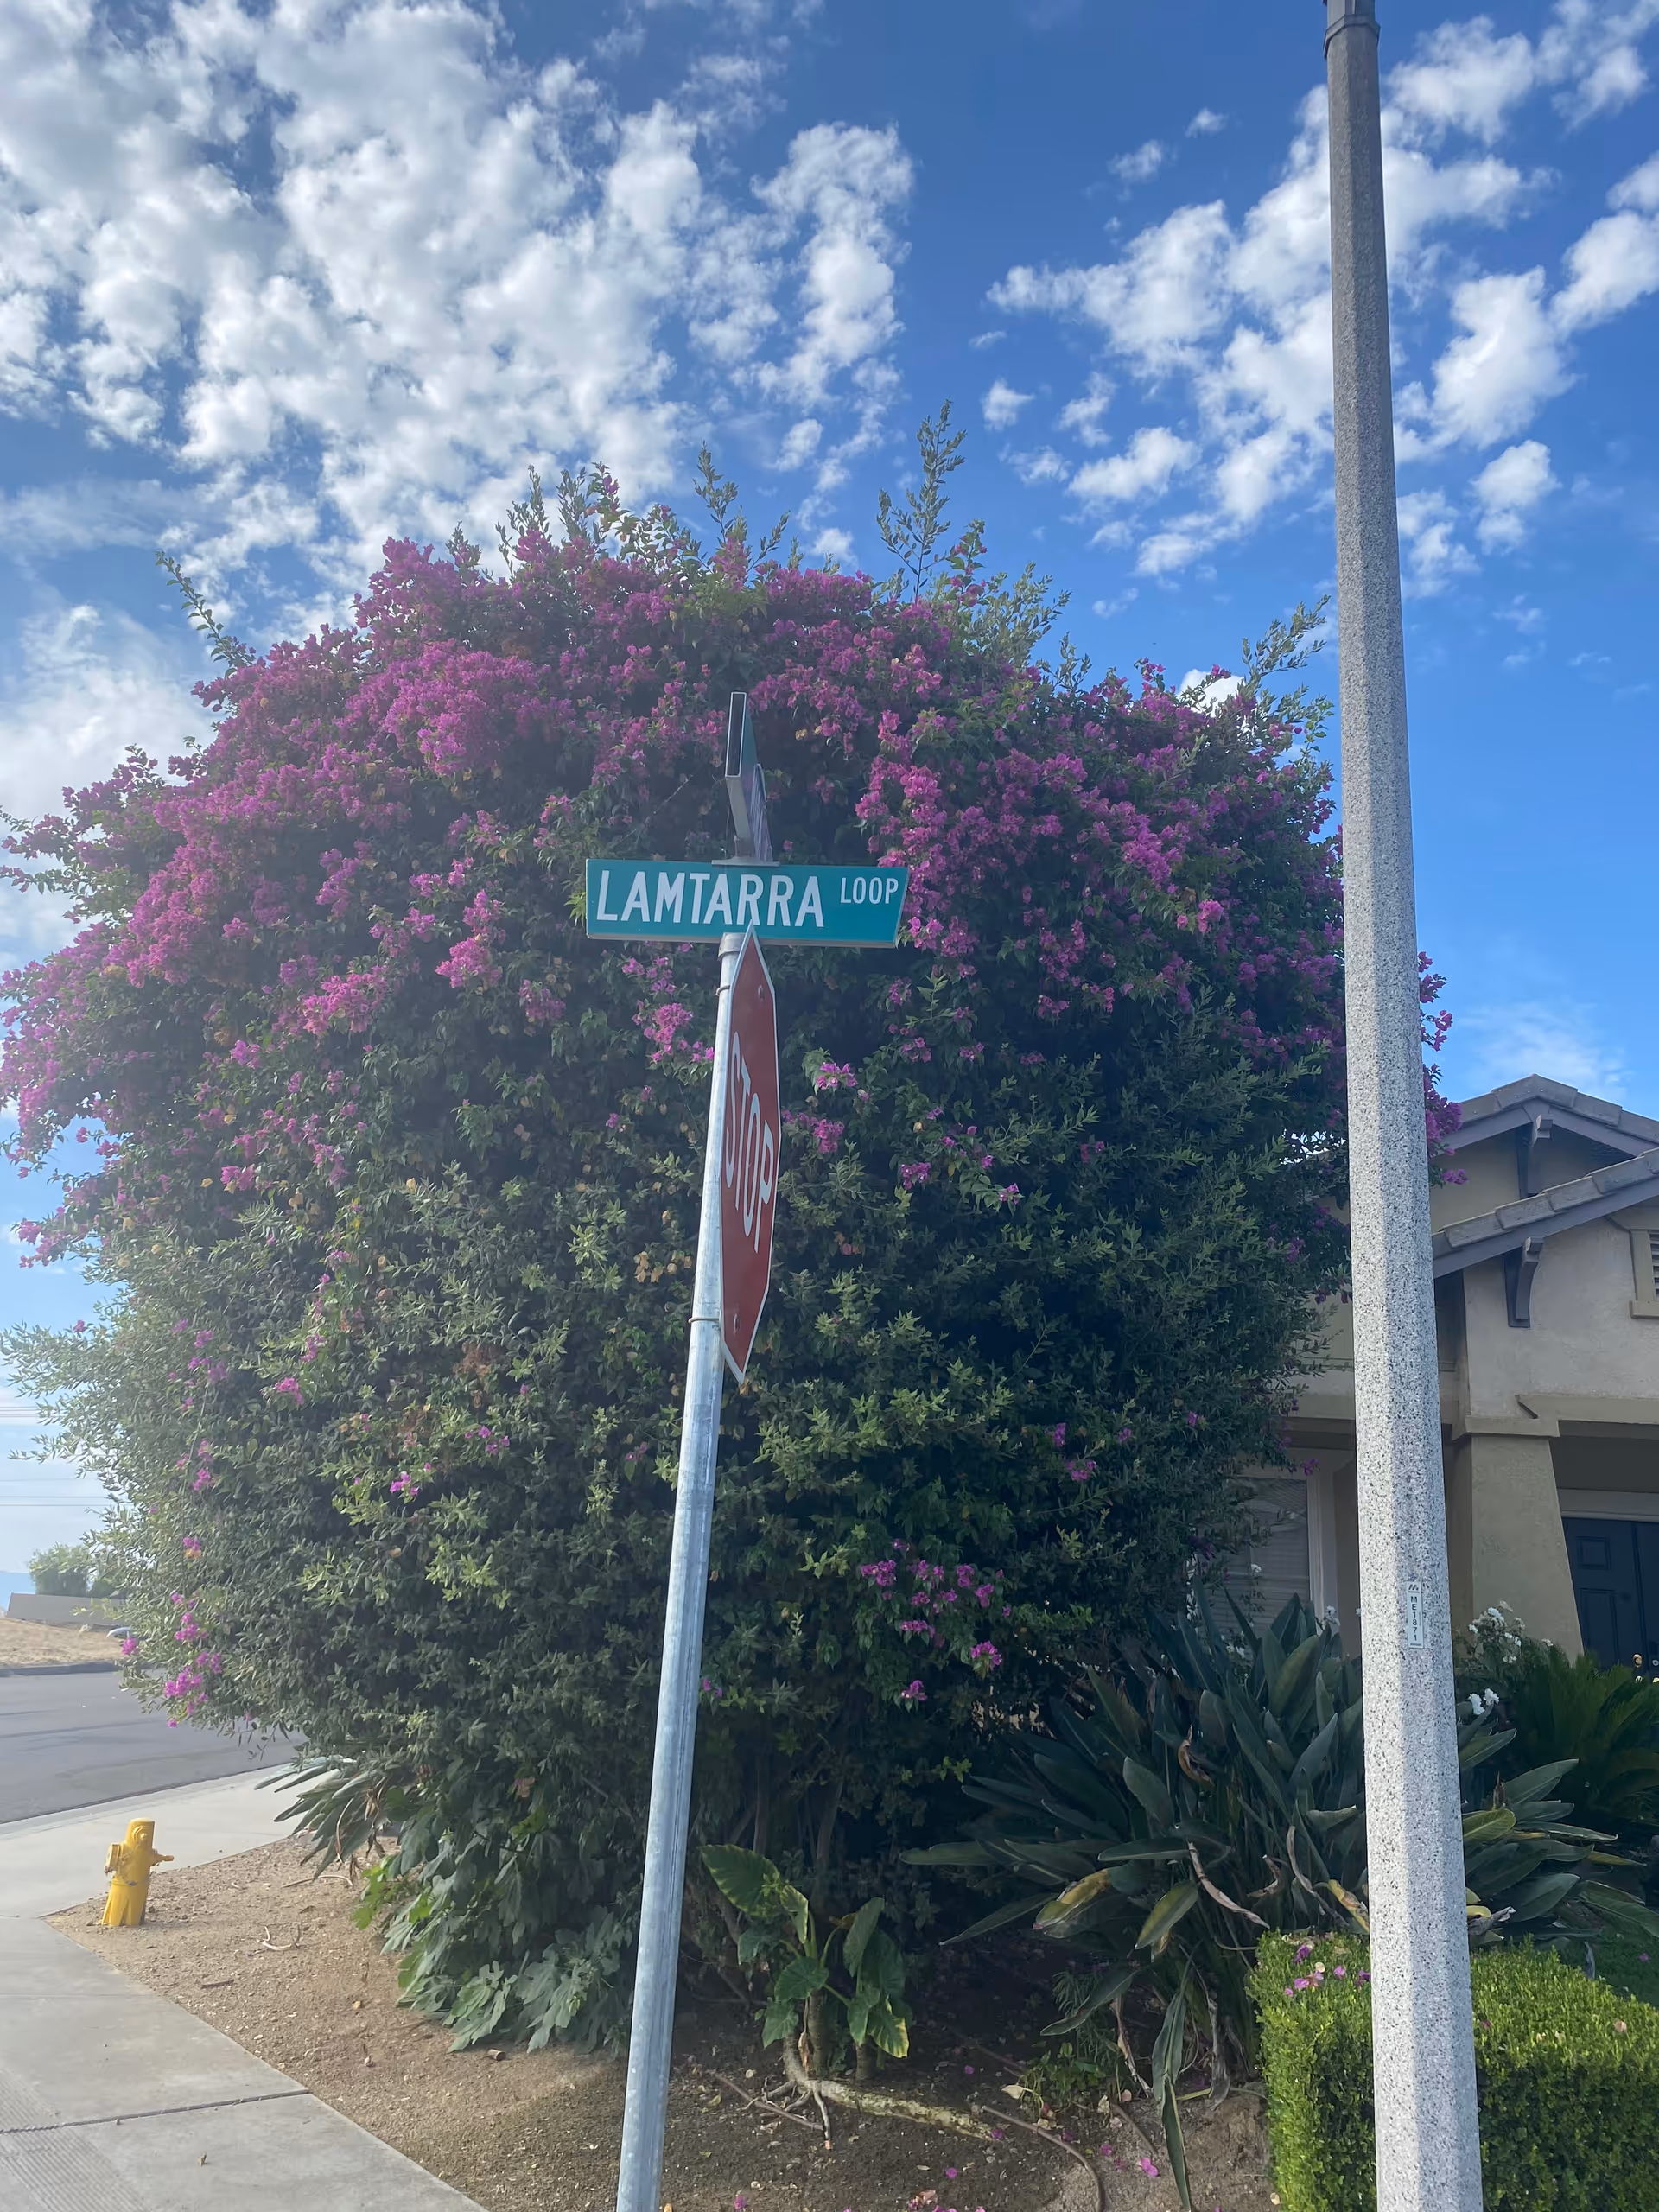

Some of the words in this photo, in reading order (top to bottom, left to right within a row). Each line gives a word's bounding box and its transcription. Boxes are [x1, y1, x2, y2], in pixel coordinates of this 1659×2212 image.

[596, 869, 824, 927] LAMTARRA
[840, 877, 899, 905] LOOP
[727, 1032, 773, 1254] STOP
